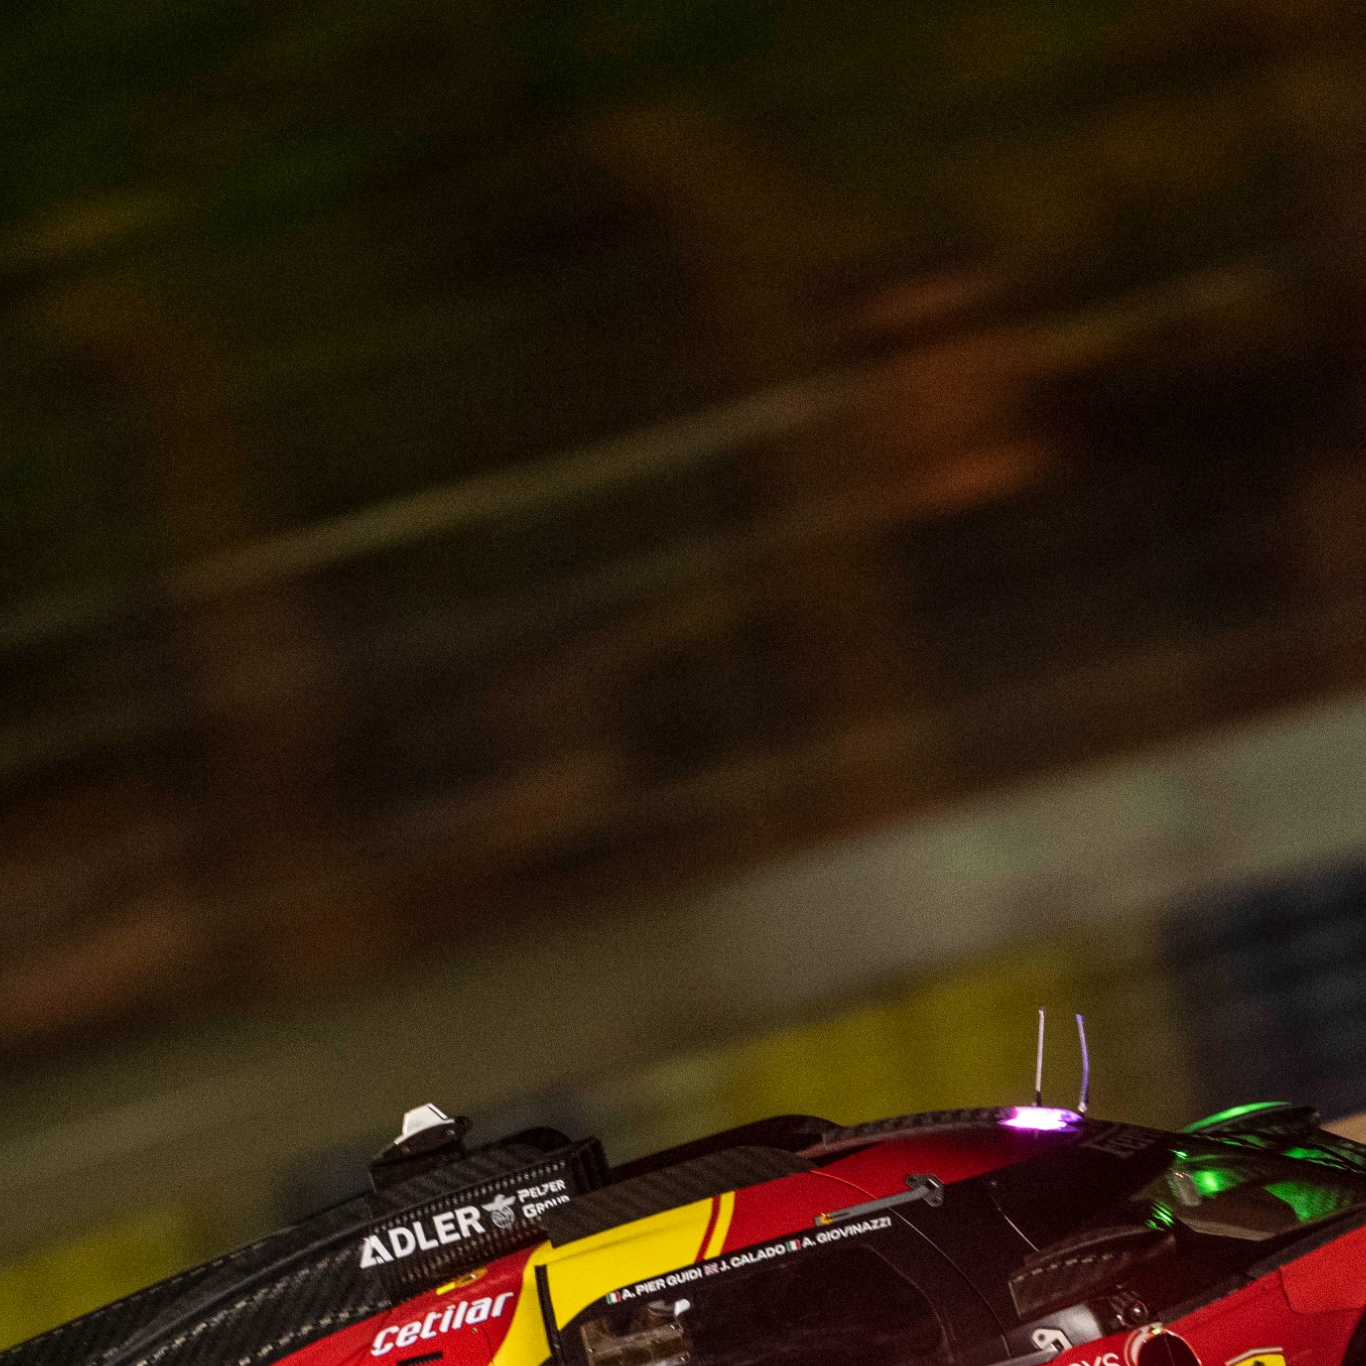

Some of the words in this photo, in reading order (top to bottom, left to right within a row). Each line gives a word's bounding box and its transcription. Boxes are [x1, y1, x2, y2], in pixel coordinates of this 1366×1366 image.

[359, 1205, 486, 1269] ADLER
[800, 1236, 816, 1249] A.
[816, 1215, 892, 1245] GIOVINAZZI
[730, 1243, 785, 1267] CALADO
[620, 1287, 636, 1301] A.
[636, 1277, 666, 1297] PIER
[666, 1267, 703, 1287] GUIDI
